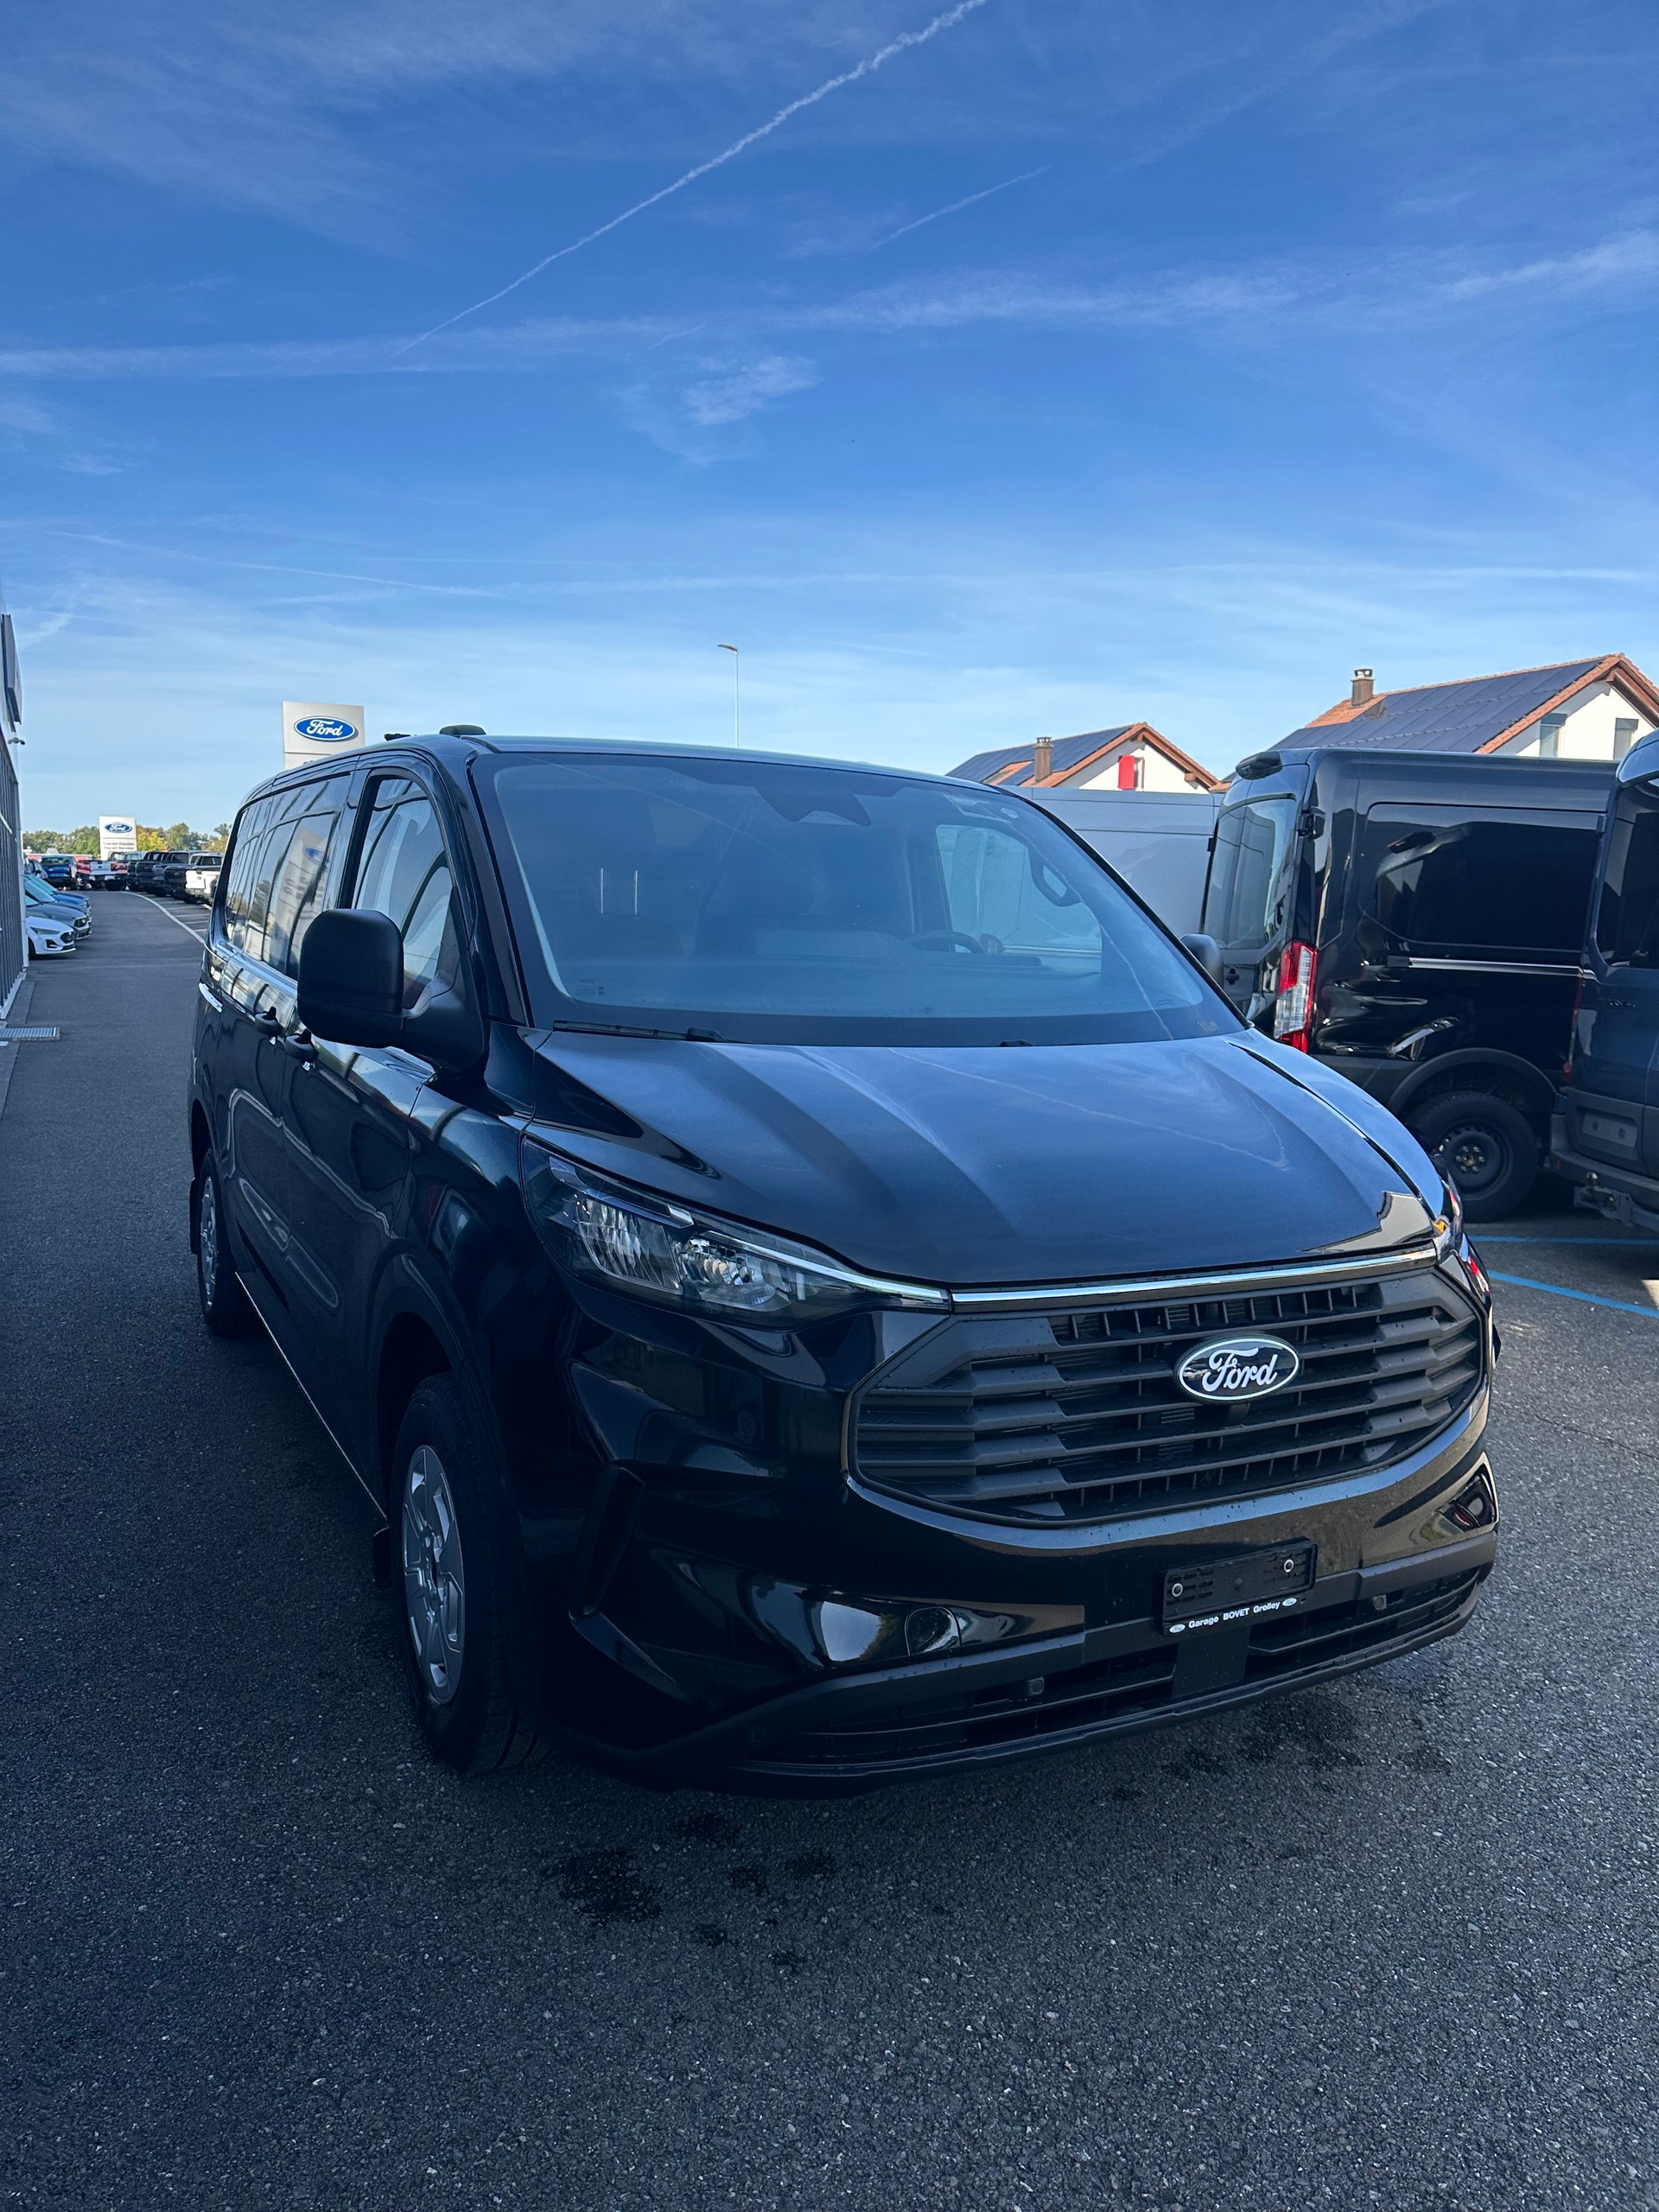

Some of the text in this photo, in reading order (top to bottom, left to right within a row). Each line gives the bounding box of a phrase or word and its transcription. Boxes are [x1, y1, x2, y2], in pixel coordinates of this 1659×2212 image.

[306, 719, 344, 736] Ford
[1201, 1346, 1279, 1393] Ford
[1188, 1616, 1219, 1629] Garage
[1223, 1608, 1250, 1621] BOVET
[1253, 1601, 1281, 1614] Grolley
